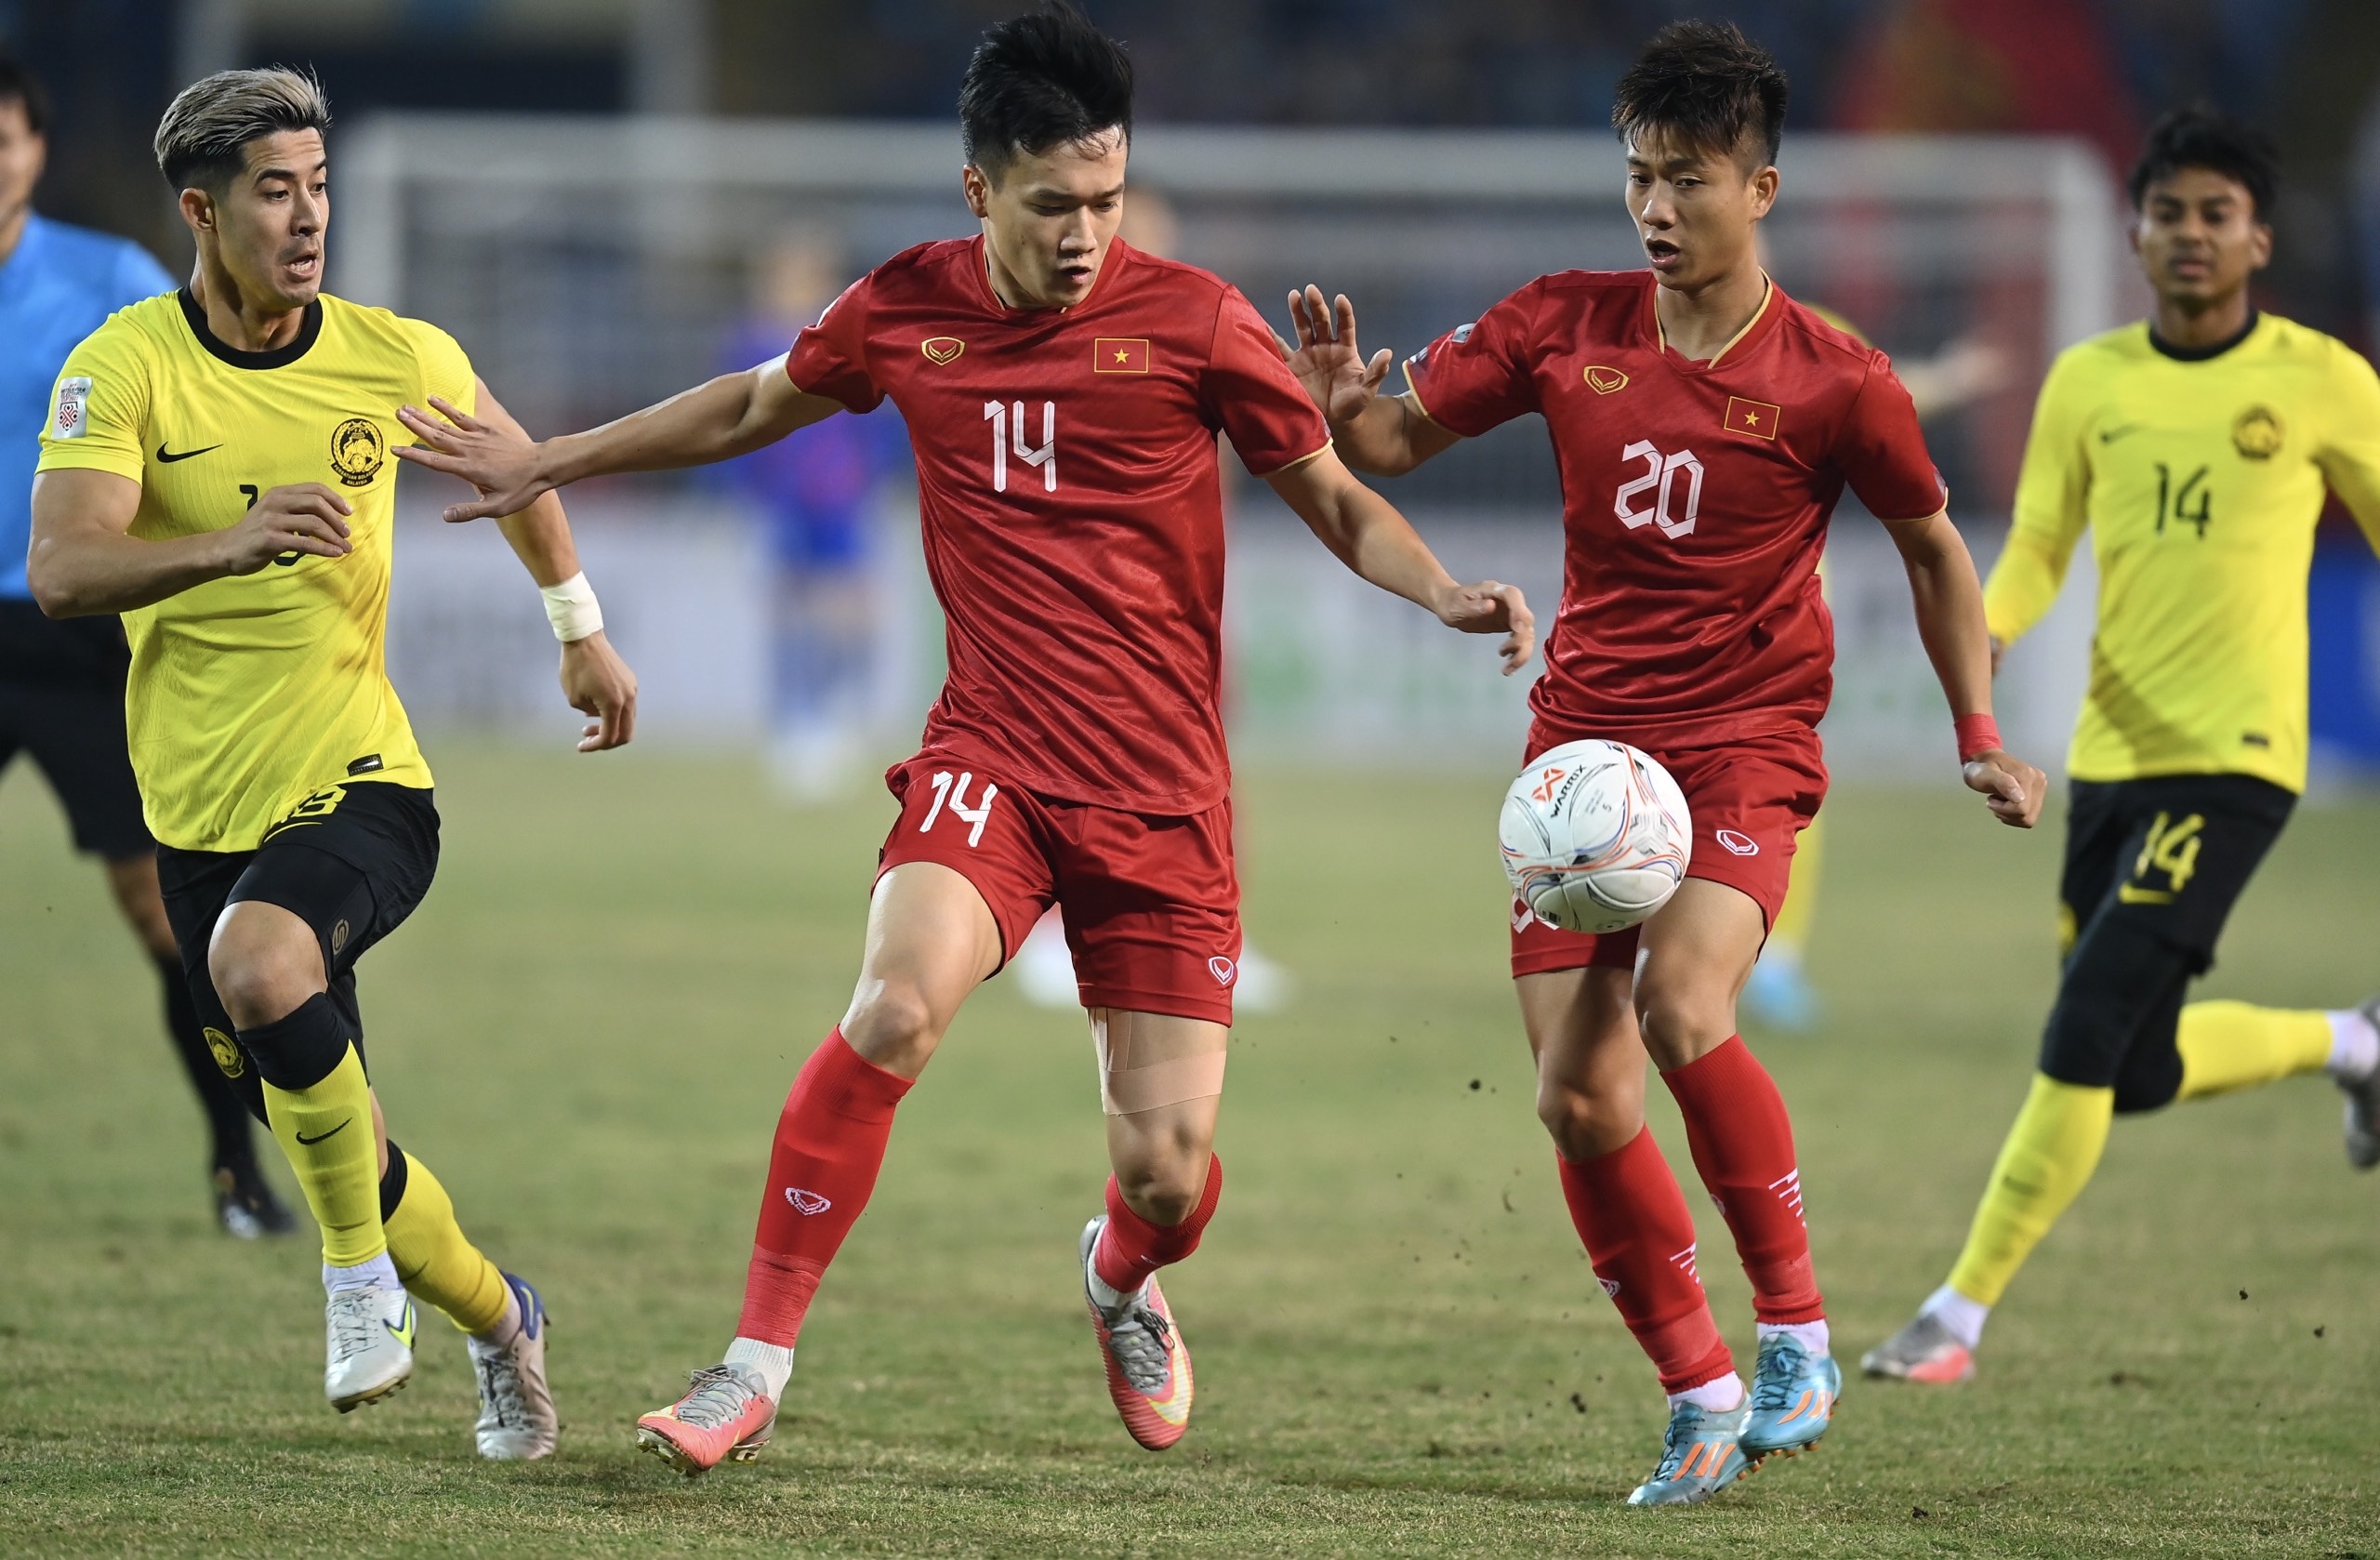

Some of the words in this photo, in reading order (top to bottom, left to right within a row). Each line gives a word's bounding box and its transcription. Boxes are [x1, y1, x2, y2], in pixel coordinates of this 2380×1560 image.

[984, 399, 1057, 493] 14
[1614, 439, 1704, 539] 20
[2153, 461, 2211, 541] 14
[919, 771, 998, 849] 14
[1550, 764, 1589, 818] WARRIX
[2135, 811, 2204, 892] 14
